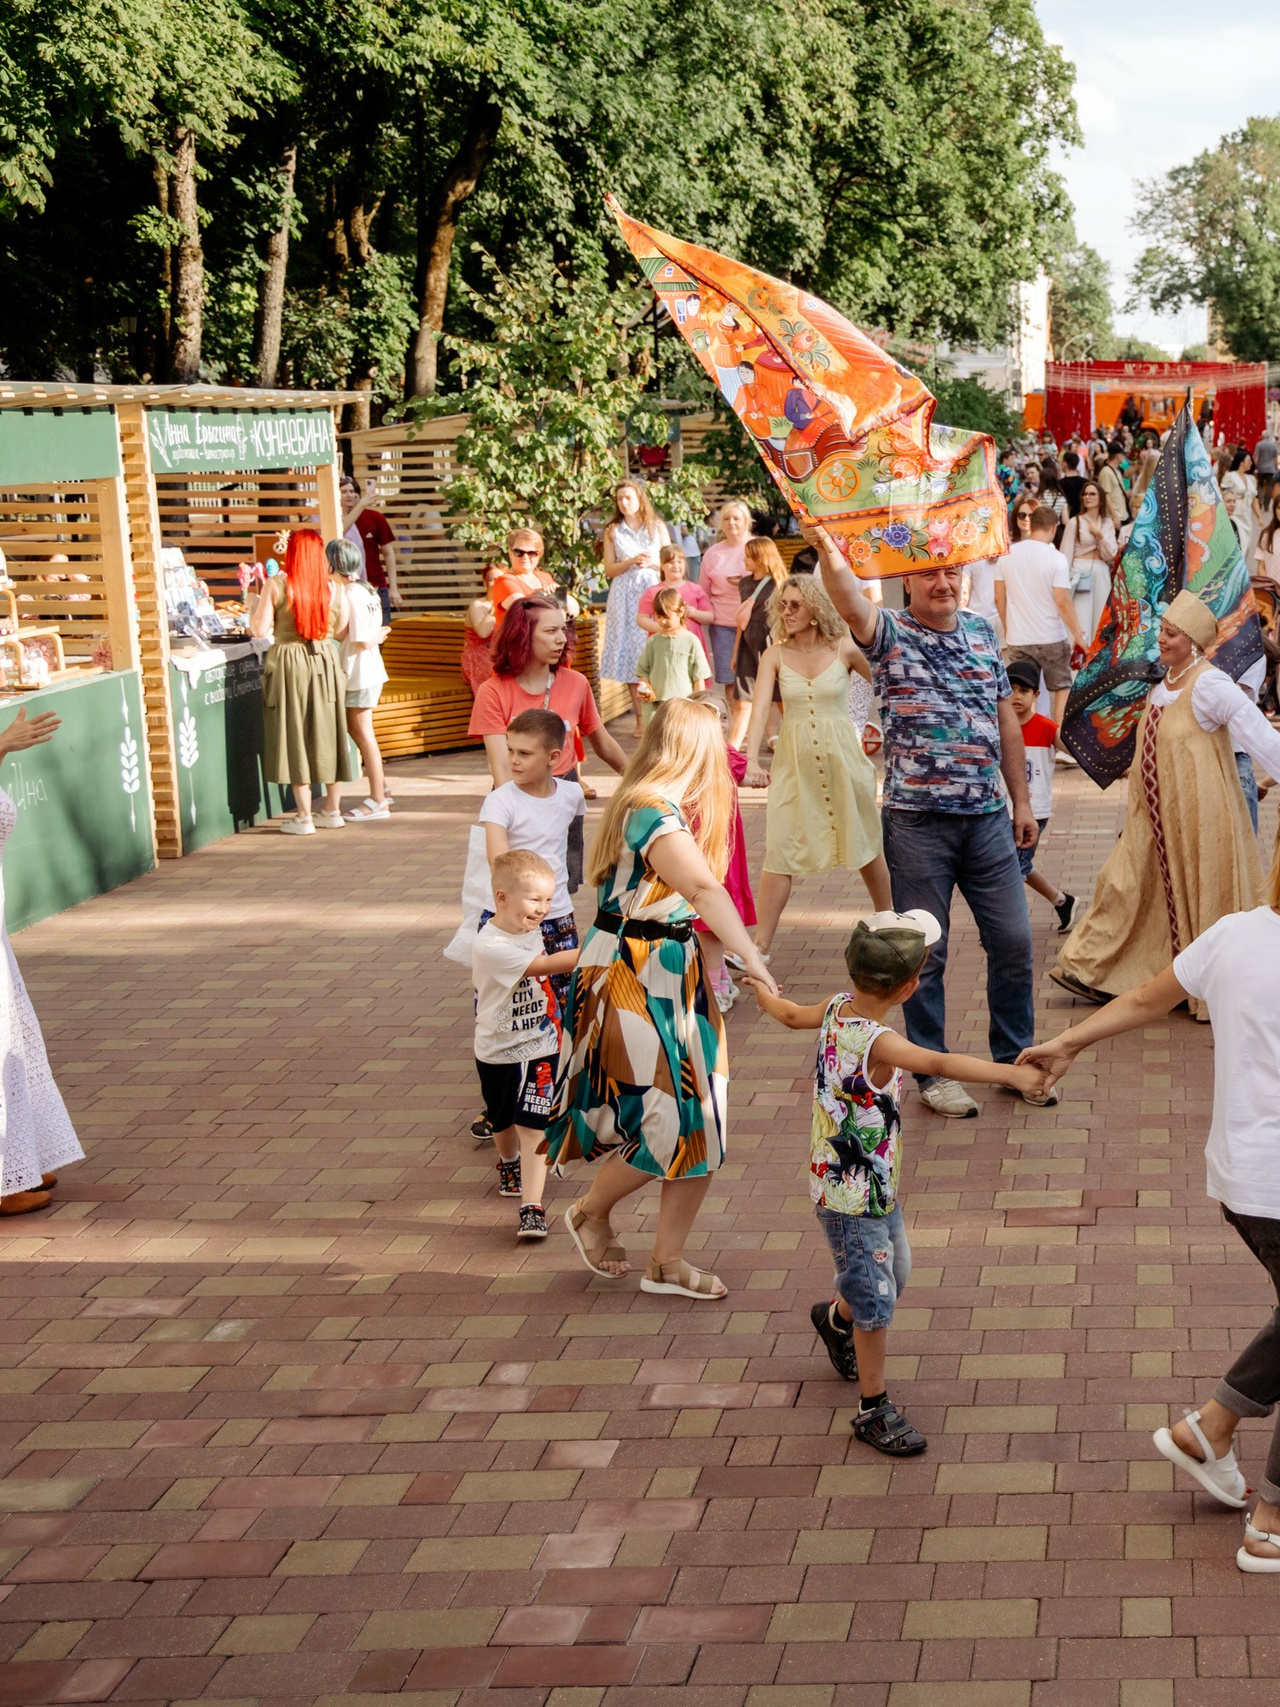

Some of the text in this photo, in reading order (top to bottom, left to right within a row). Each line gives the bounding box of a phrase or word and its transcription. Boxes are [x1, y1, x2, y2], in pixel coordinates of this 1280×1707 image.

[165, 414, 191, 446] Анна
[512, 988, 533, 1004] CITY
[511, 1000, 544, 1018] NEEDS
[511, 1020, 519, 1032] A
[522, 1103, 529, 1112] A
[524, 1094, 551, 1107] NEEDS
